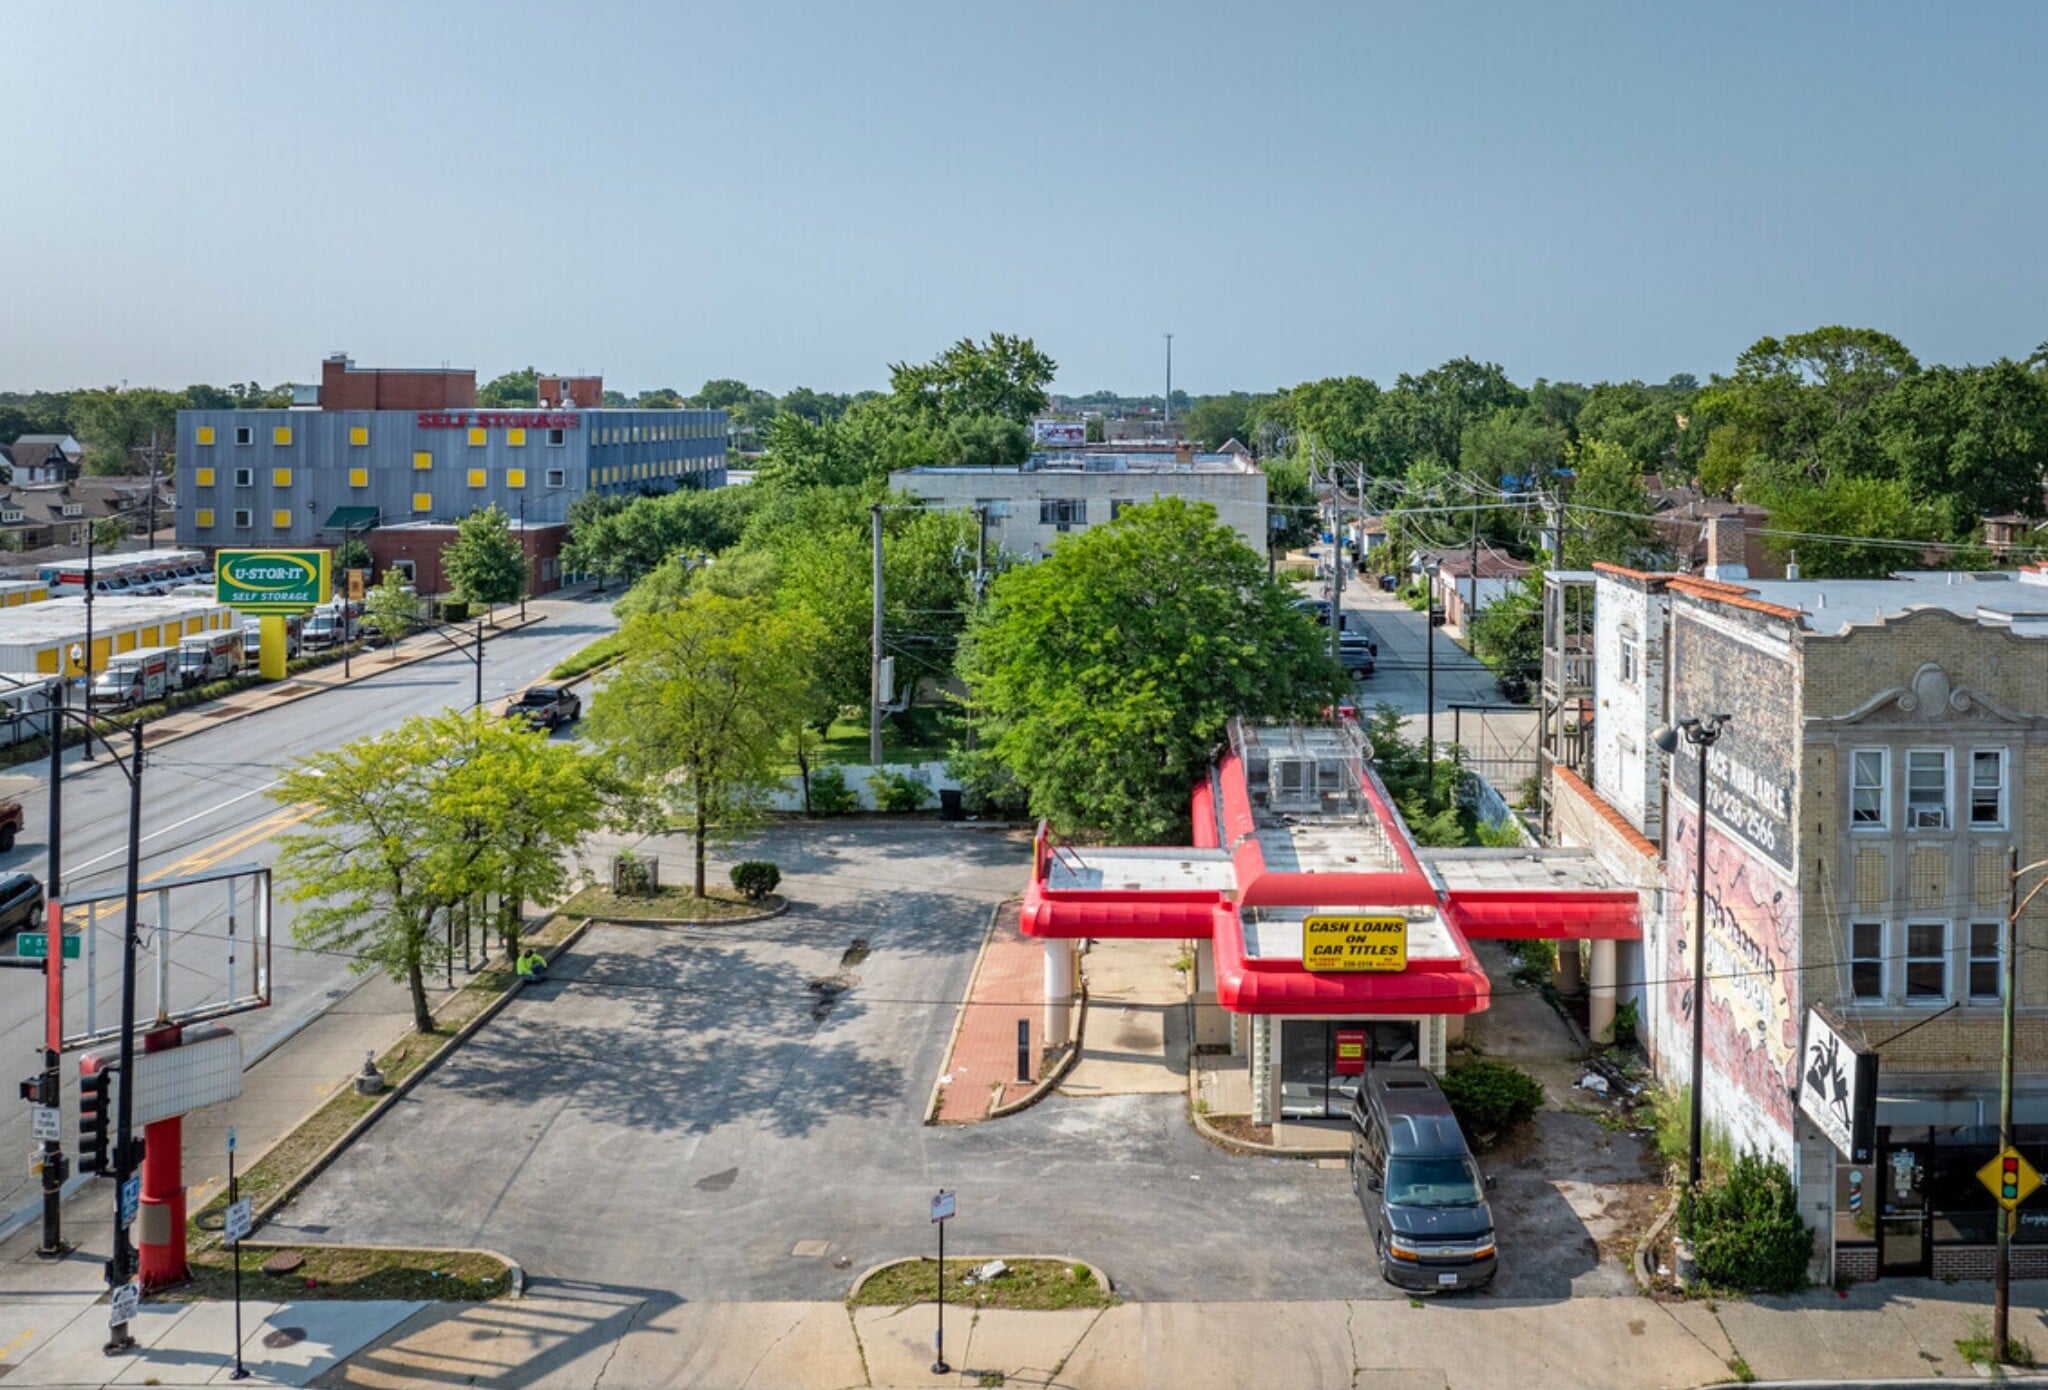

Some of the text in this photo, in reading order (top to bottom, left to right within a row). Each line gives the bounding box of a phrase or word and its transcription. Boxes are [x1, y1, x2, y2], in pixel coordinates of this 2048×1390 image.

[417, 413, 580, 429] SELF STORAGE
[232, 592, 309, 601] SELF STORAGE
[1704, 745, 1728, 781] PACE
[1730, 759, 1786, 819] AVAILABLE
[1310, 922, 1403, 933] CASH LOANS
[1345, 935, 1367, 944] ON
[1313, 945, 1399, 955] CAR TITLES
